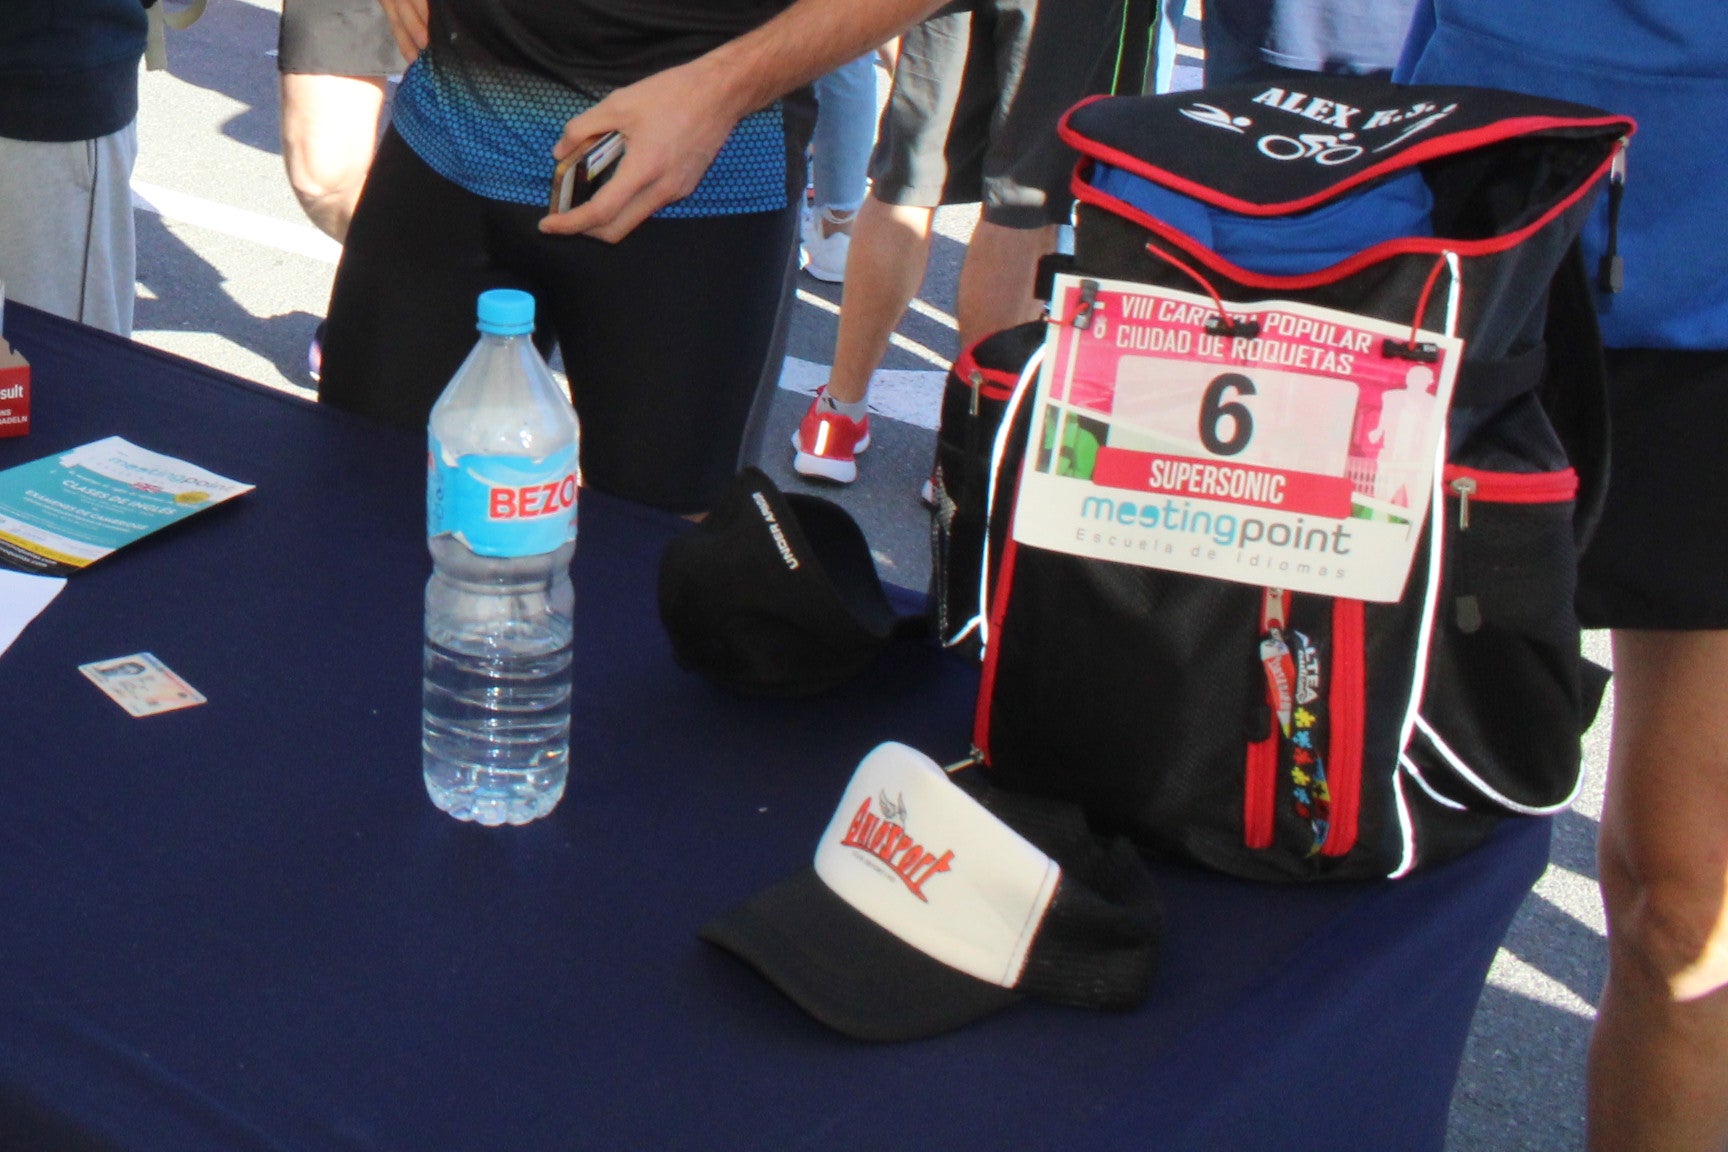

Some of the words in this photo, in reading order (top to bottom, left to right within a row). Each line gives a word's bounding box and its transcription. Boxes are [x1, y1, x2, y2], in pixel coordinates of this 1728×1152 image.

[1251, 86, 1363, 129] ALEX
[1116, 323, 1192, 355] CIUDAD
[1197, 332, 1225, 358] DE
[1230, 336, 1355, 376] ROQUETAS
[1120, 295, 1154, 321] VIII
[1262, 312, 1373, 355] POPULAR
[1197, 371, 1258, 457] 6
[1148, 458, 1287, 506] SUPERSONIC
[768, 522, 800, 570] UNDER
[1080, 493, 1353, 557] meetingpoint
[1075, 527, 1175, 555] Escuela
[1190, 542, 1218, 562] de
[1235, 550, 1348, 580] Idiomas
